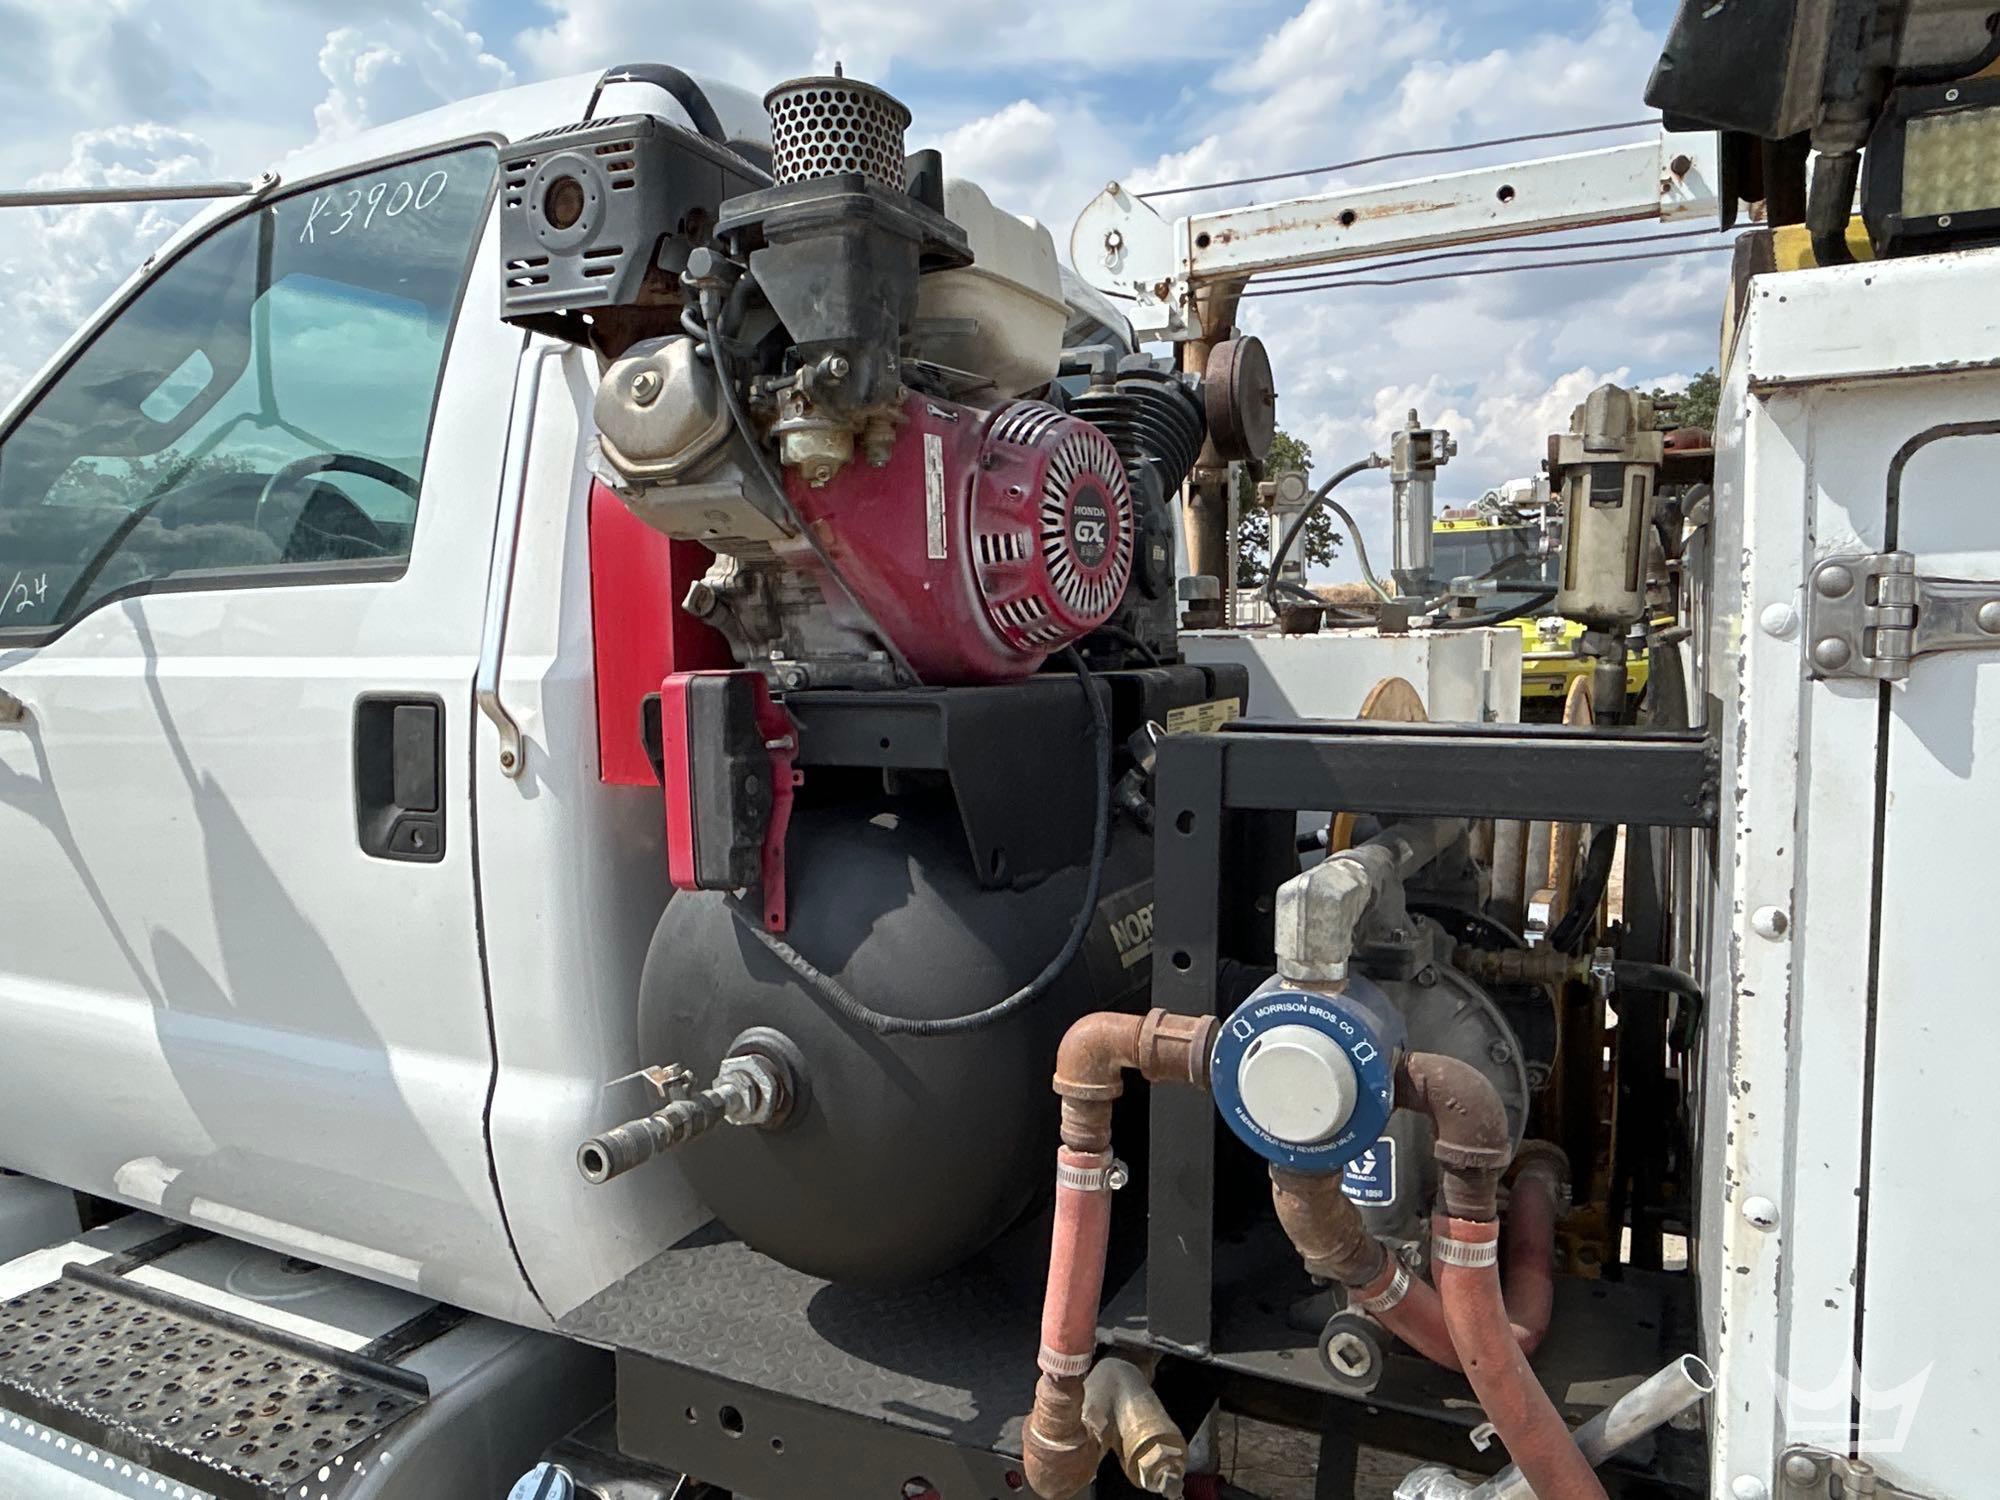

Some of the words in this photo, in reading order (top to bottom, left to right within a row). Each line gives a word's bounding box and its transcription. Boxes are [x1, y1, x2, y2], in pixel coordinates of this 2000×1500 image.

[299, 171, 448, 243] K-3900
[1074, 505, 1105, 517] HONDA
[1074, 520, 1105, 543] GX
[1110, 902, 1154, 954] NOR
[1254, 1002, 1308, 1019] MORRISON
[1308, 1005, 1338, 1025] BROS.
[1346, 1172, 1377, 1182] GRACO
